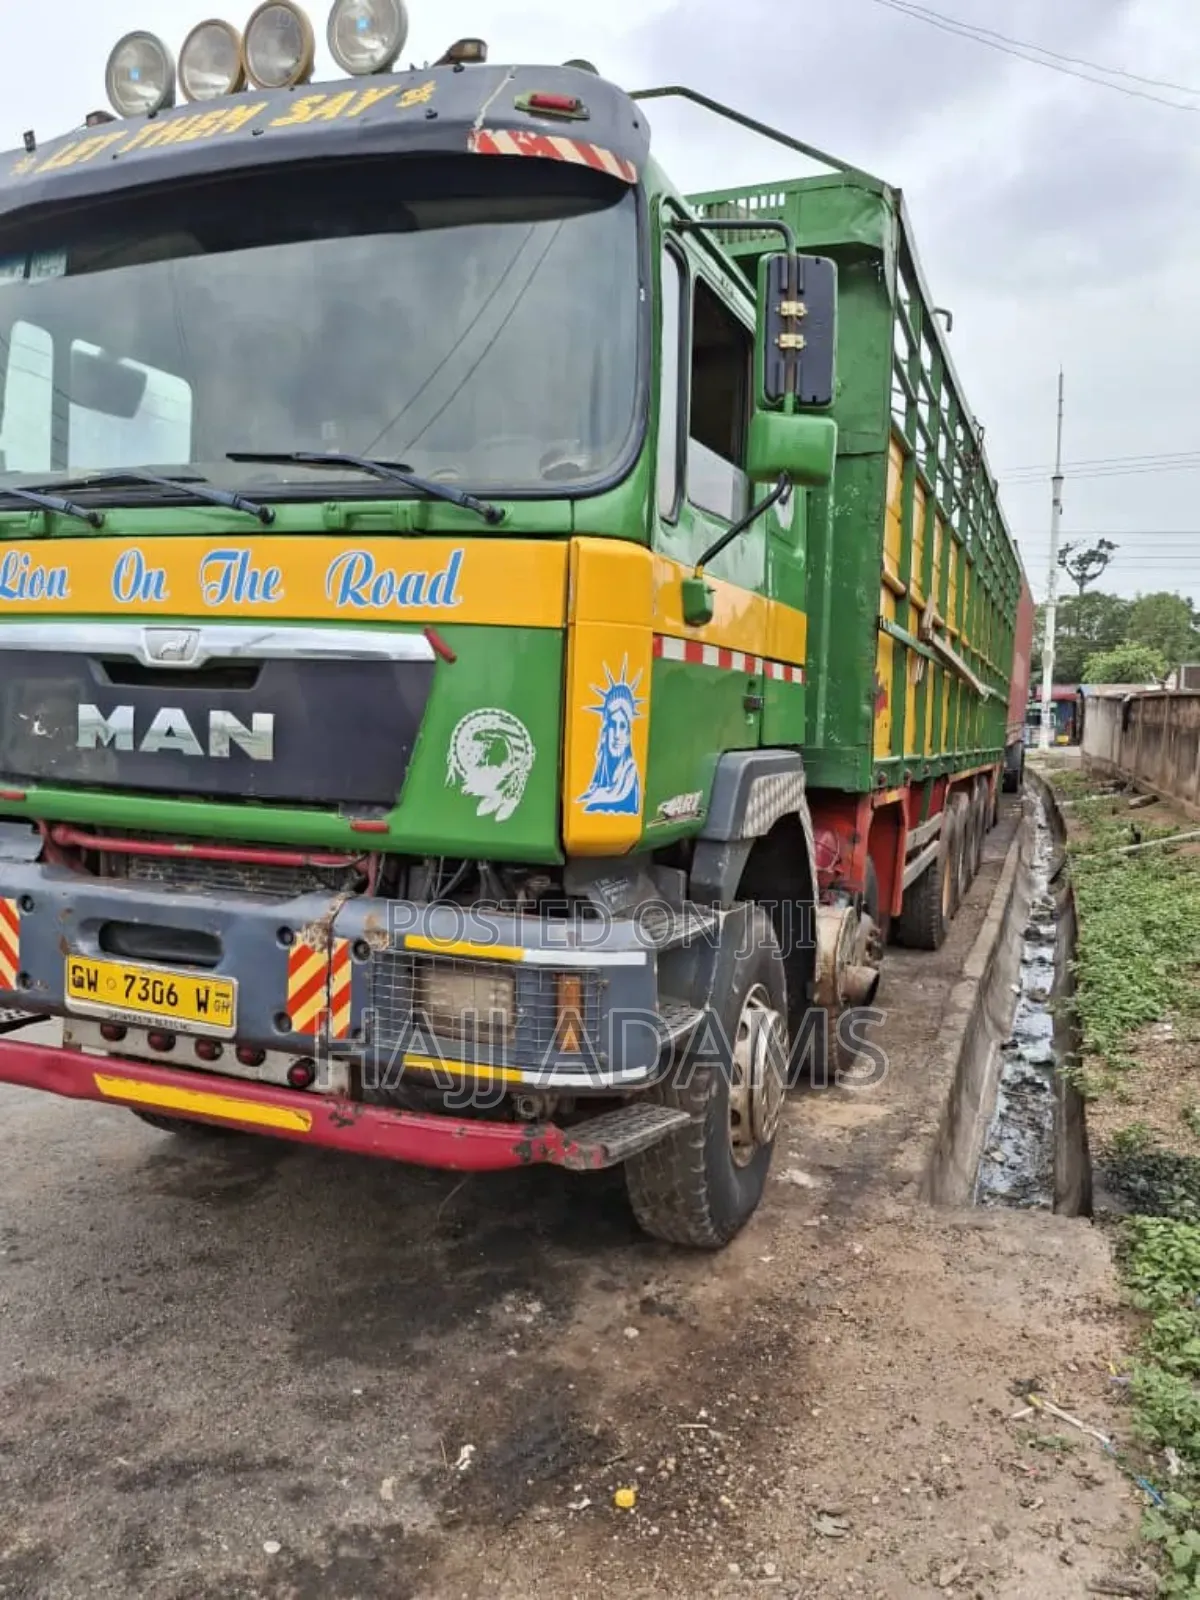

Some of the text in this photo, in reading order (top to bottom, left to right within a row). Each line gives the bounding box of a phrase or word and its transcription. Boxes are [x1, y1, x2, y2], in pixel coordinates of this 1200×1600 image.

[117, 102, 269, 153] THEM
[268, 84, 401, 127] SAY
[0, 547, 463, 609] Lion On The Road
[76, 703, 274, 760] MAN
[71, 964, 210, 1014] GW 7306 W
